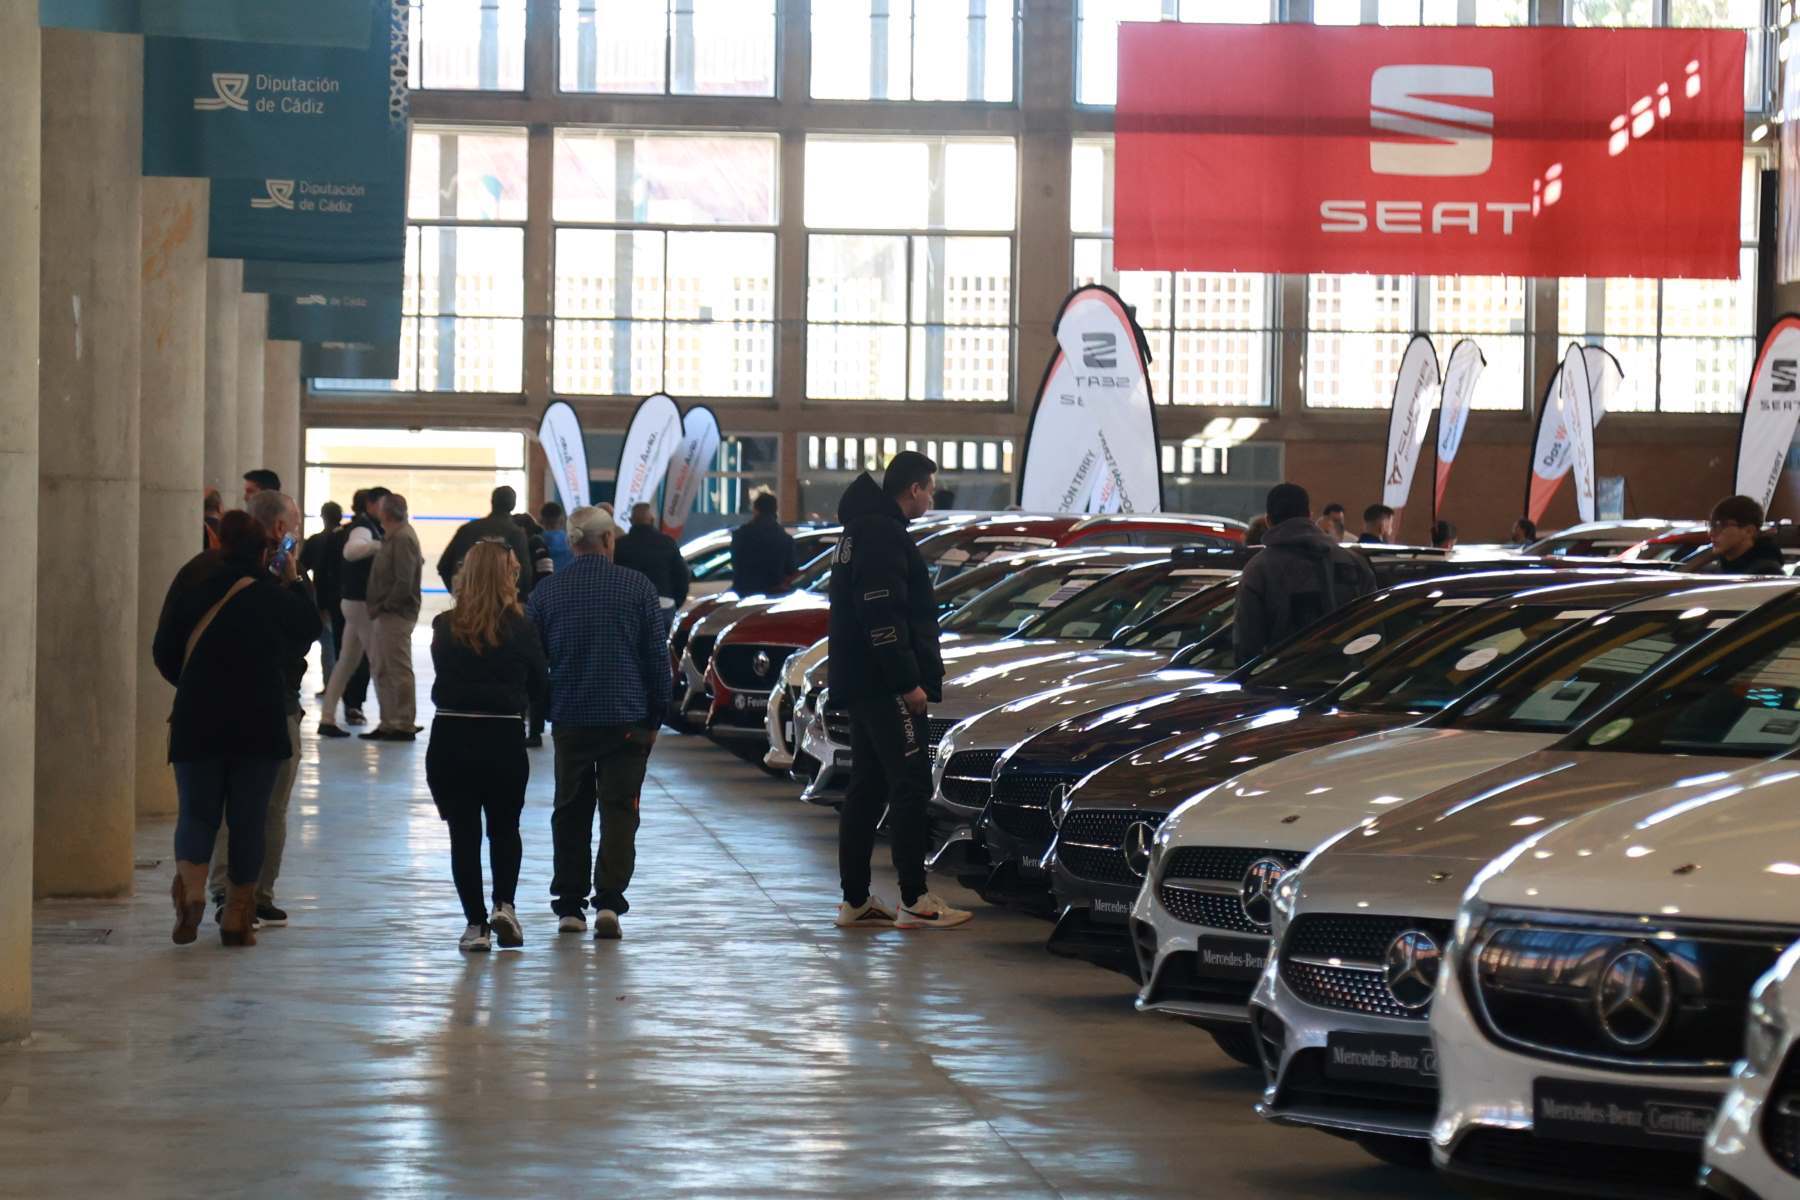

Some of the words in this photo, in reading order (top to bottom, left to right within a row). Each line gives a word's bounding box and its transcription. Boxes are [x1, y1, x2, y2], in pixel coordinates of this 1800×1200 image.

[256, 74, 339, 93] Diputación
[256, 96, 275, 112] de
[281, 96, 325, 114] Cádiz
[300, 182, 365, 198] Diputación
[299, 199, 314, 211] de
[319, 198, 353, 213] Cádiz
[1320, 200, 1531, 235] SEAT
[1543, 442, 1562, 467] Das
[1072, 448, 1096, 486] TERRY
[904, 715, 914, 743] YORK
[1094, 898, 1134, 913] Mercedes-B
[1203, 949, 1265, 969] Mercedes-Ben
[1332, 1045, 1419, 1070] Mercedes-Benz
[1540, 1097, 1643, 1126] Mercedes-Benz
